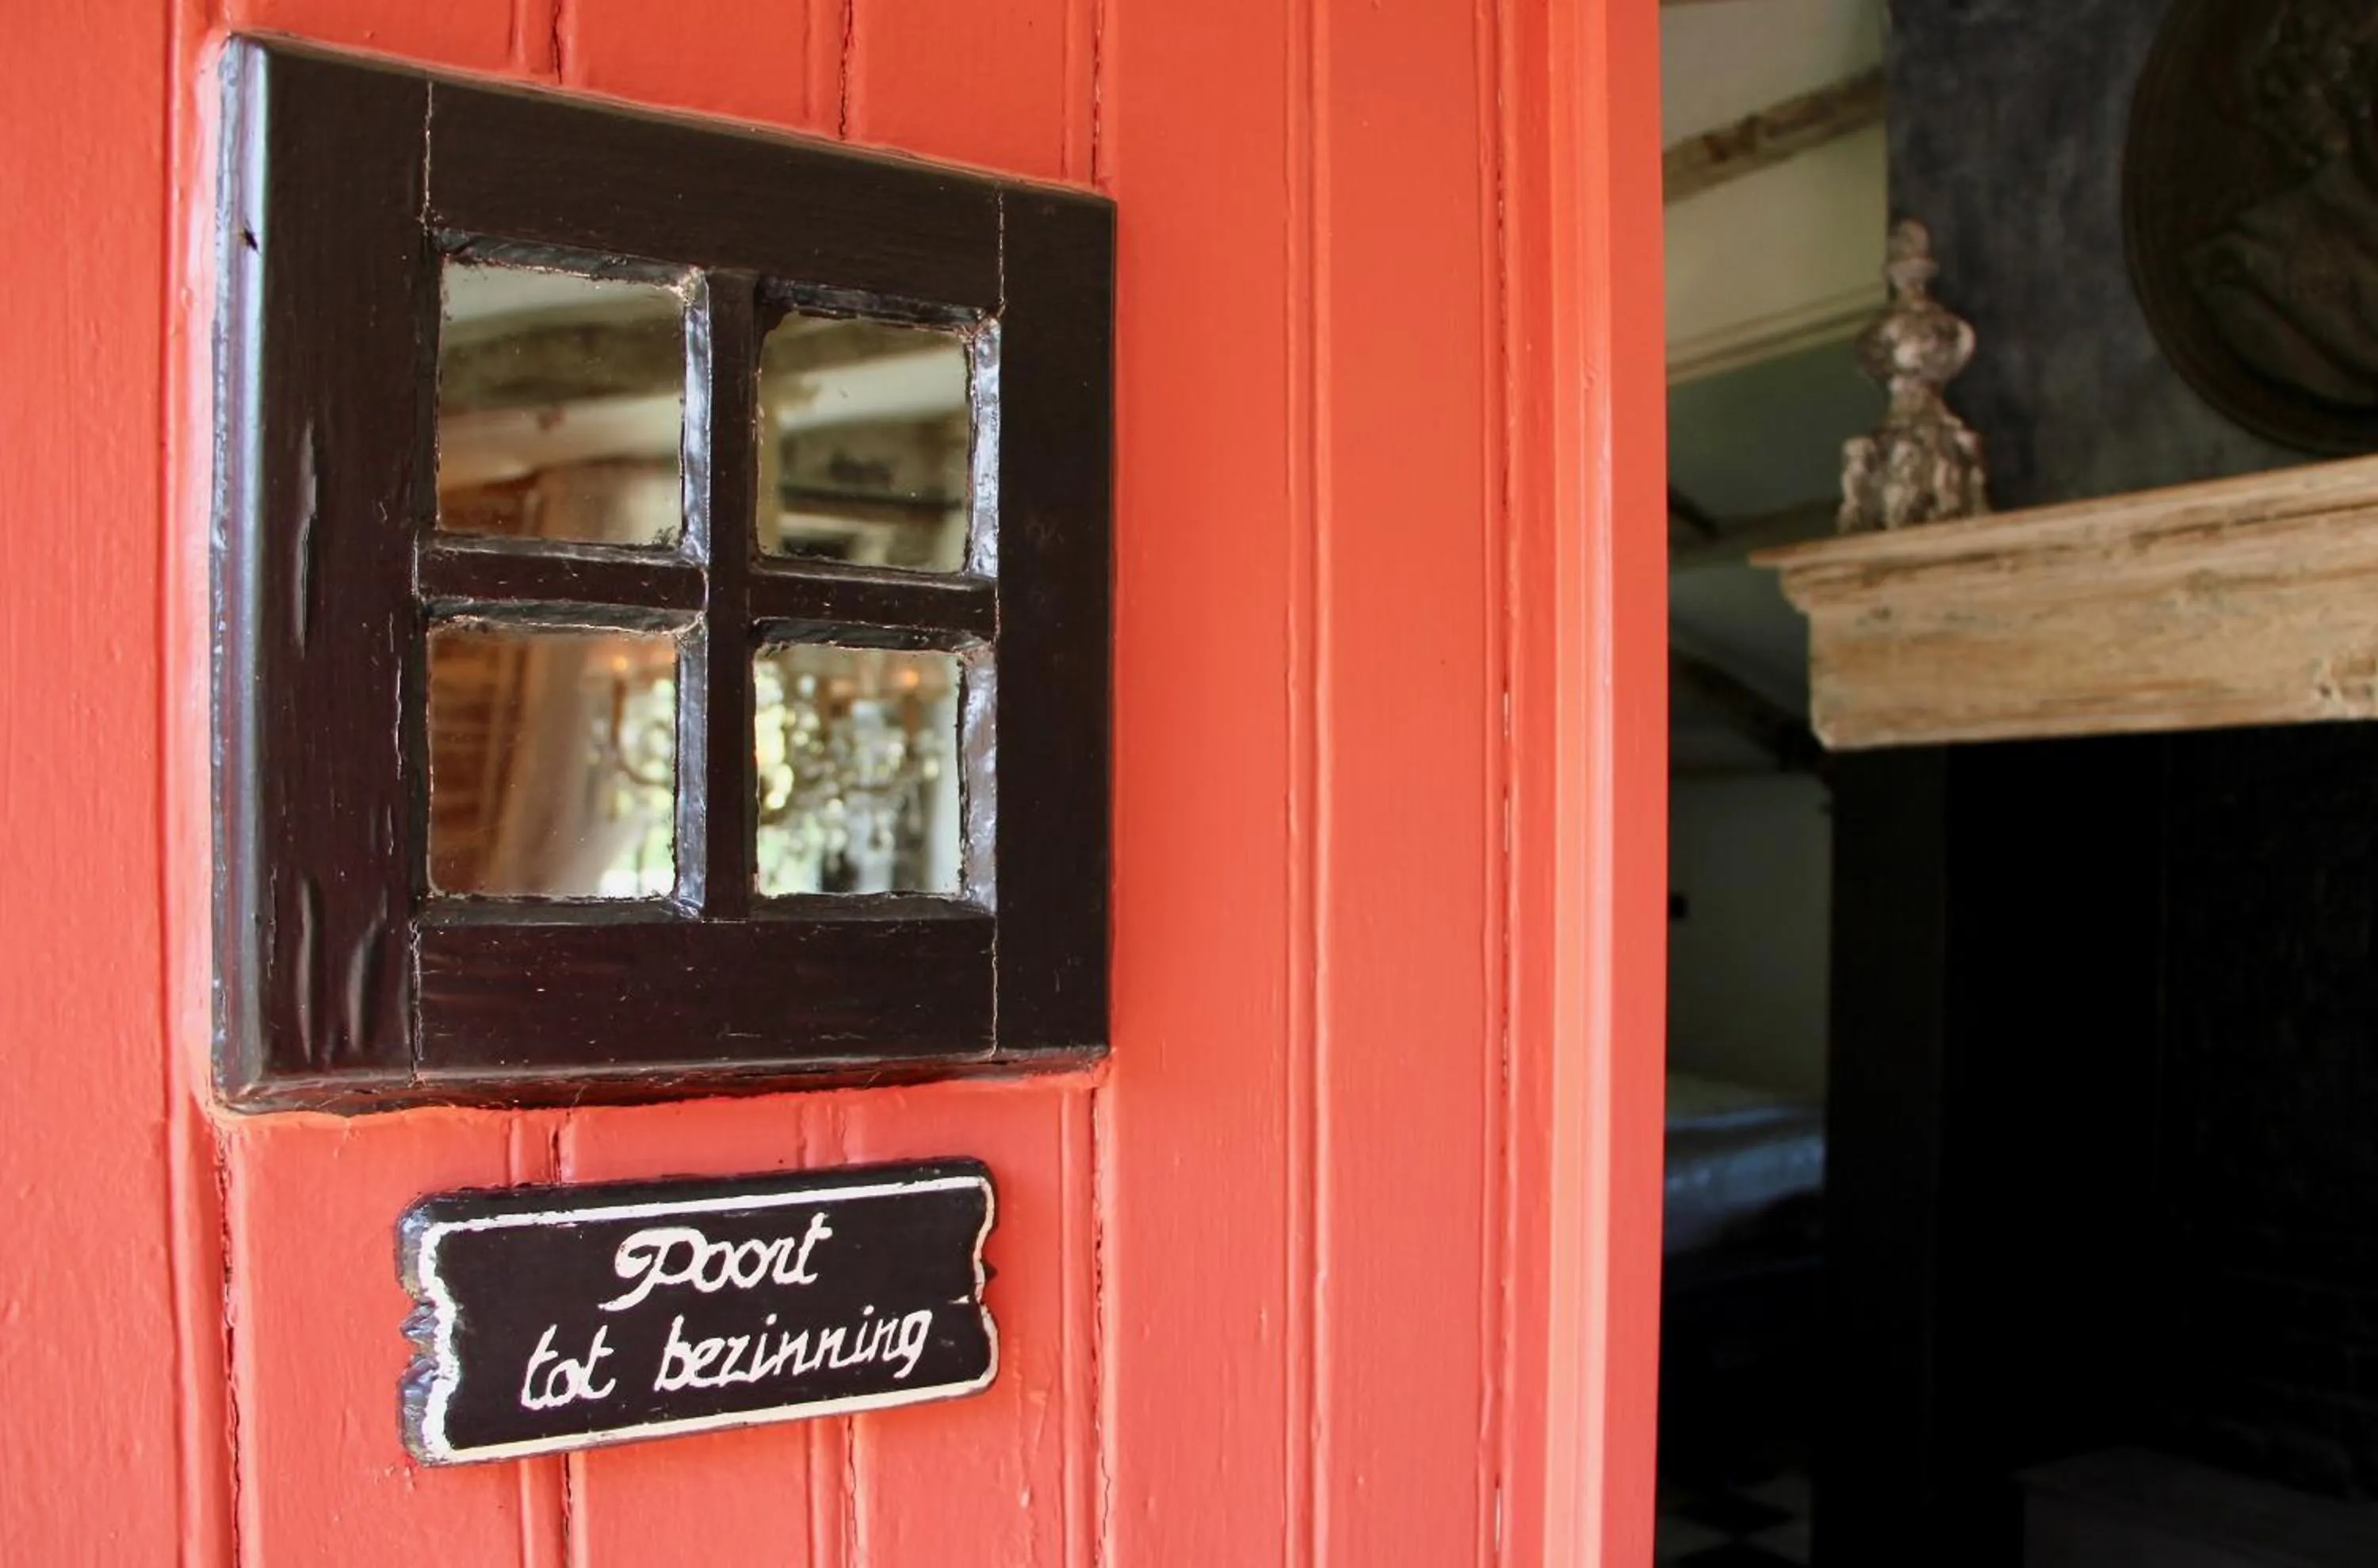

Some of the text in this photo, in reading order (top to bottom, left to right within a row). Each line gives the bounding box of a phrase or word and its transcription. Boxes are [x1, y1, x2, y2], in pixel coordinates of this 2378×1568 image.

[598, 1211, 833, 1312] Poort
[520, 1305, 933, 1411] tot bezinning
